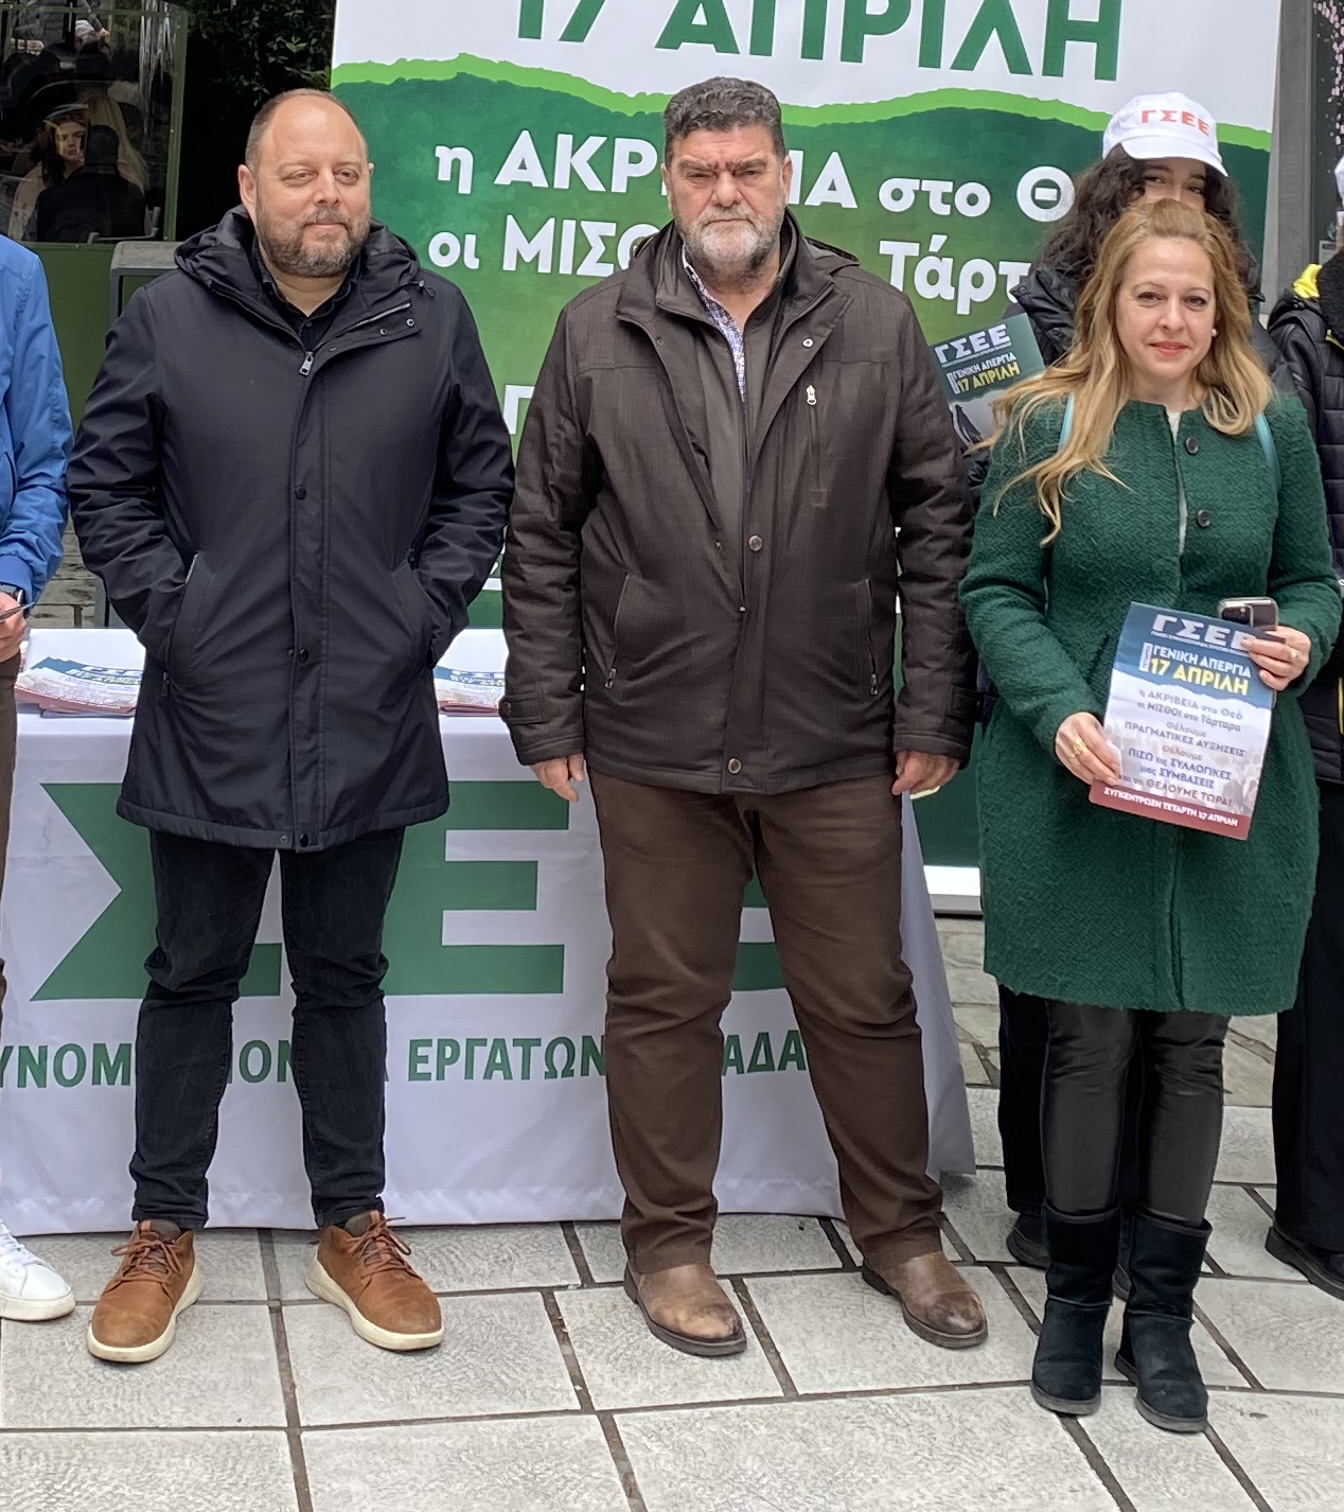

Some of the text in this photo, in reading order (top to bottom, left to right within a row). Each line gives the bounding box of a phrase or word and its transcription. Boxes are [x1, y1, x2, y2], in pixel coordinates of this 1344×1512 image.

[1141, 109, 1210, 137] ΓΣΕΕ
[435, 144, 473, 194] η
[879, 176, 990, 217] στο
[429, 231, 481, 270] οι
[935, 324, 1010, 363] ΓΣΕΕ
[953, 364, 980, 379] ΓΕΝΙΚΗ
[982, 352, 1017, 370] ΑΠΕΡΓΙΑ
[957, 362, 1021, 392] 17 ΑΠΡΙΛΗ
[1149, 658, 1249, 696] 17 ΑΠΡΙΛΗ
[1153, 646, 1251, 678] ΓΕΝΙΚΗ ΑΠΕΡΓΙΑ
[1148, 691, 1198, 710] ΑΚΡΙΒΕΙΑ
[1125, 721, 1194, 745] ΠΡΑΓΜΑΤΙΚΕΣ
